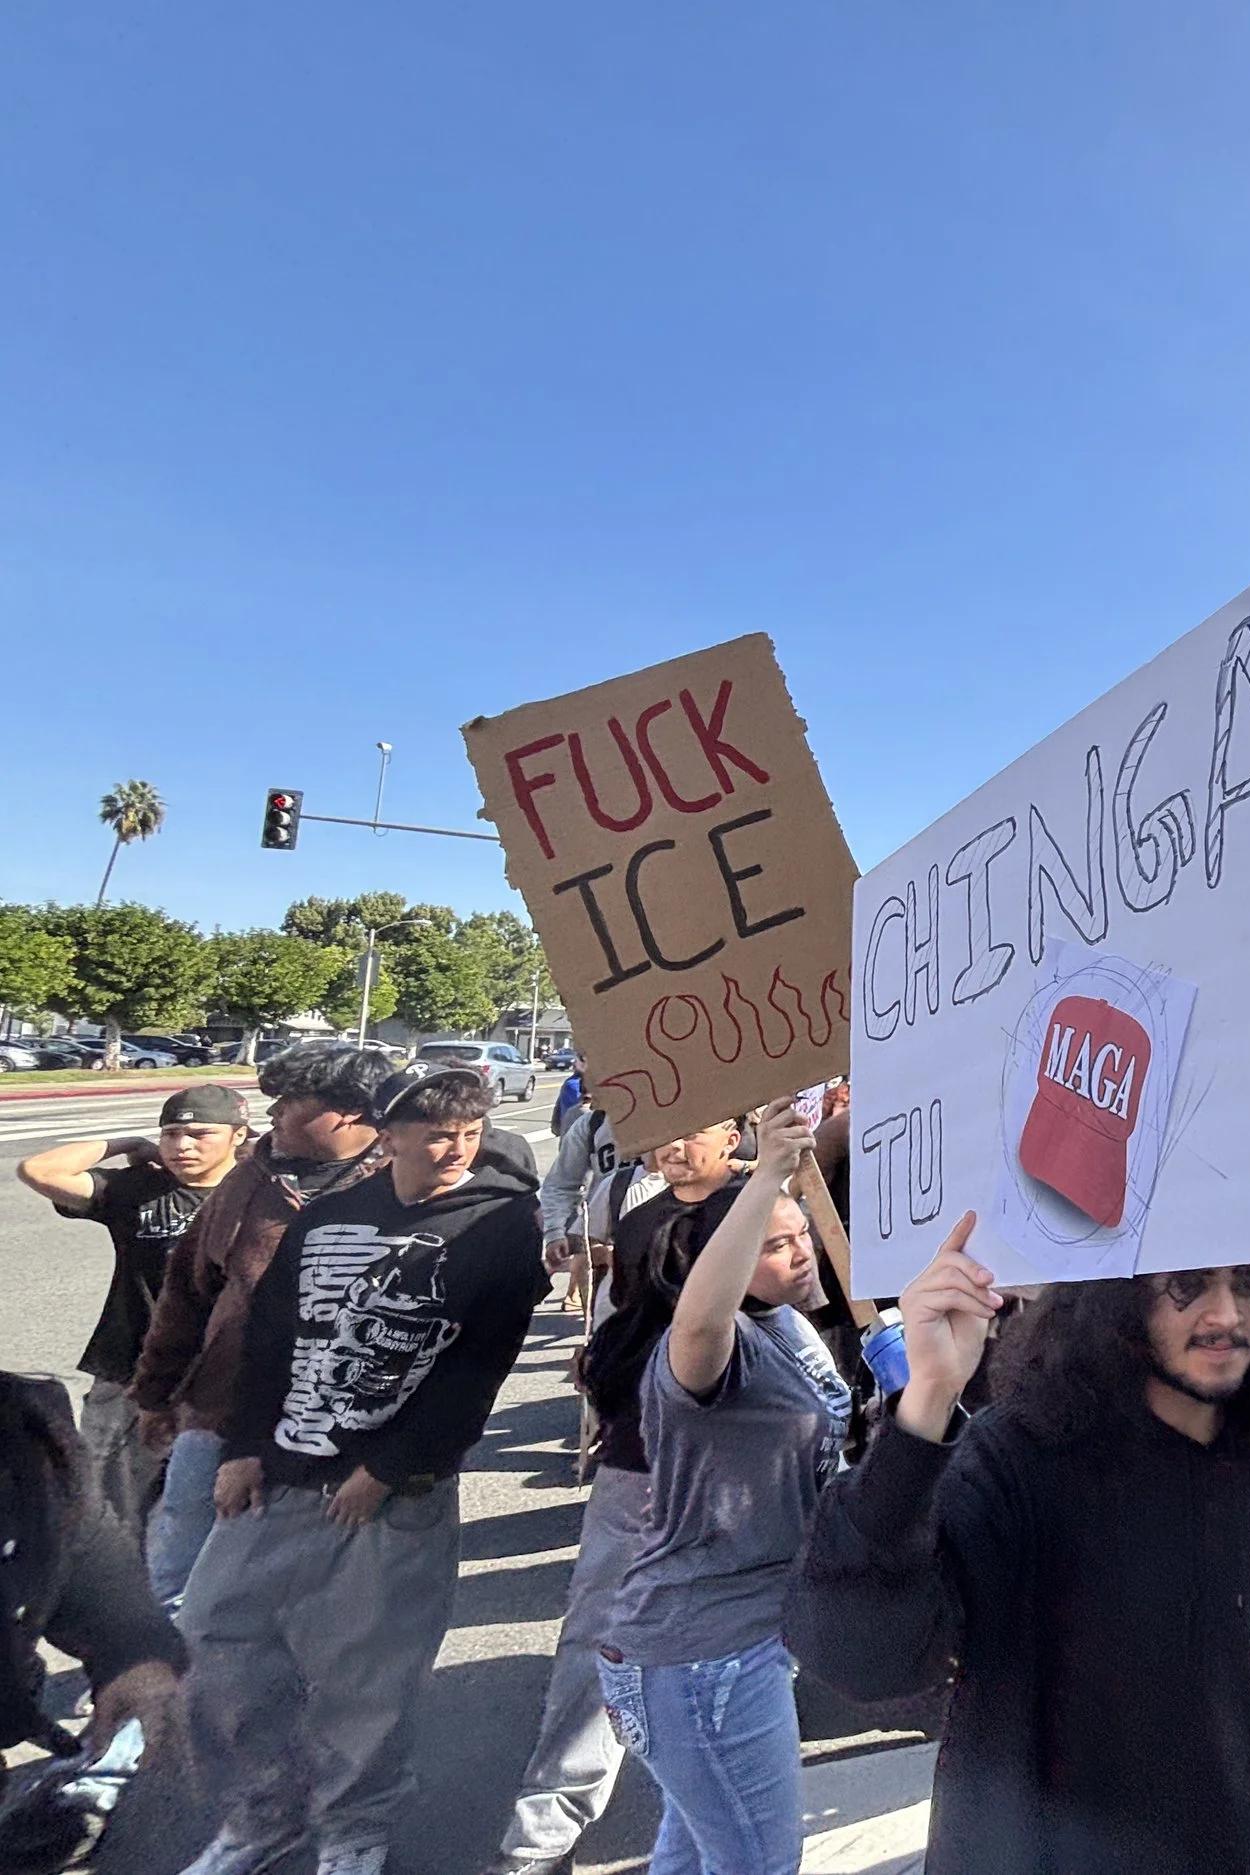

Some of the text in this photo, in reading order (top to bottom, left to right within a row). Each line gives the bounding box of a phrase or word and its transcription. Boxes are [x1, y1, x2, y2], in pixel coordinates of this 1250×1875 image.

[505, 680, 770, 860] FUCK
[552, 809, 805, 995] ICE
[1043, 1021, 1138, 1121] MAGA
[863, 1099, 943, 1239] TU
[298, 1223, 393, 1323] SYRUP
